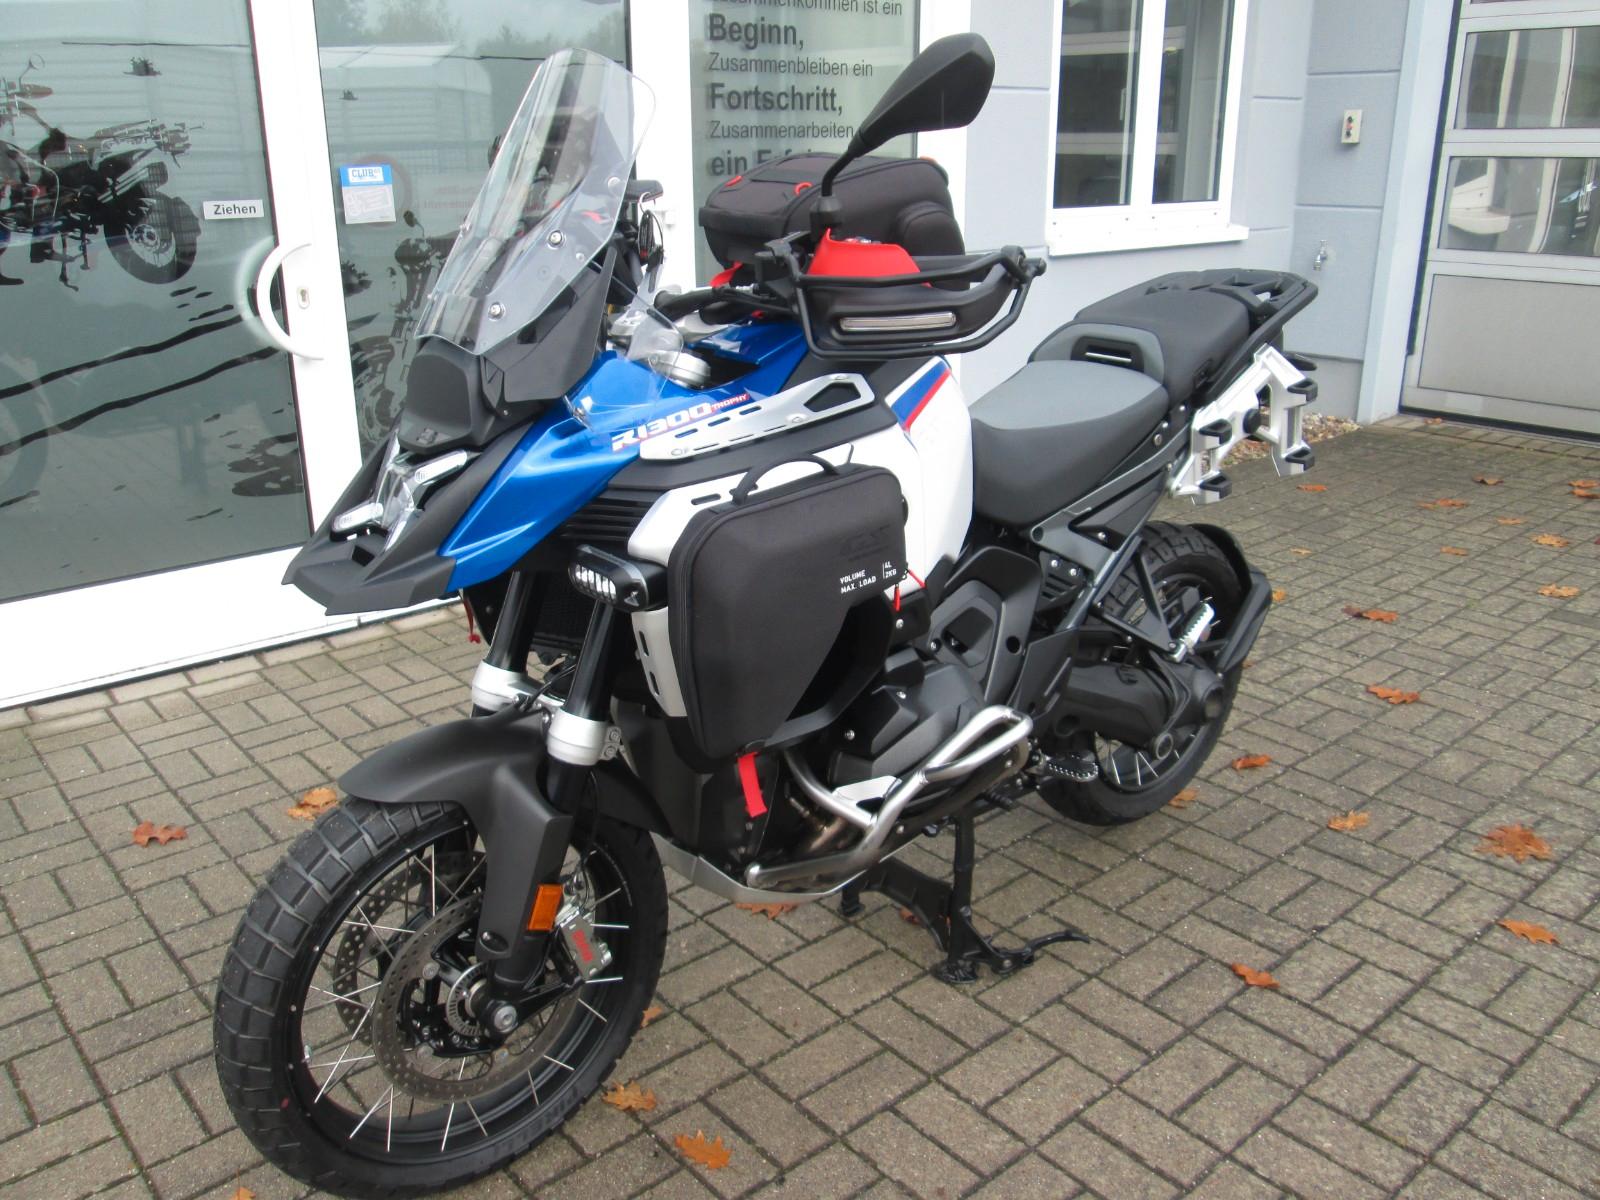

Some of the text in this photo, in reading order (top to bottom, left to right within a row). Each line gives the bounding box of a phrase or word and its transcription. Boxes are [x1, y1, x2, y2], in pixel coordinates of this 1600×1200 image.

[882, 1, 903, 15] ein
[708, 13, 804, 49] Beginn,
[708, 52, 873, 77] Zusammenbleiben ein
[709, 83, 843, 115] Fortschritt,
[709, 120, 854, 139] Zusammenarbeiten
[711, 150, 748, 176] ein
[213, 203, 257, 216] Ziehen
[712, 394, 747, 409] TROPHY
[840, 569, 866, 583] VOLUME
[859, 576, 876, 587] LOAD
